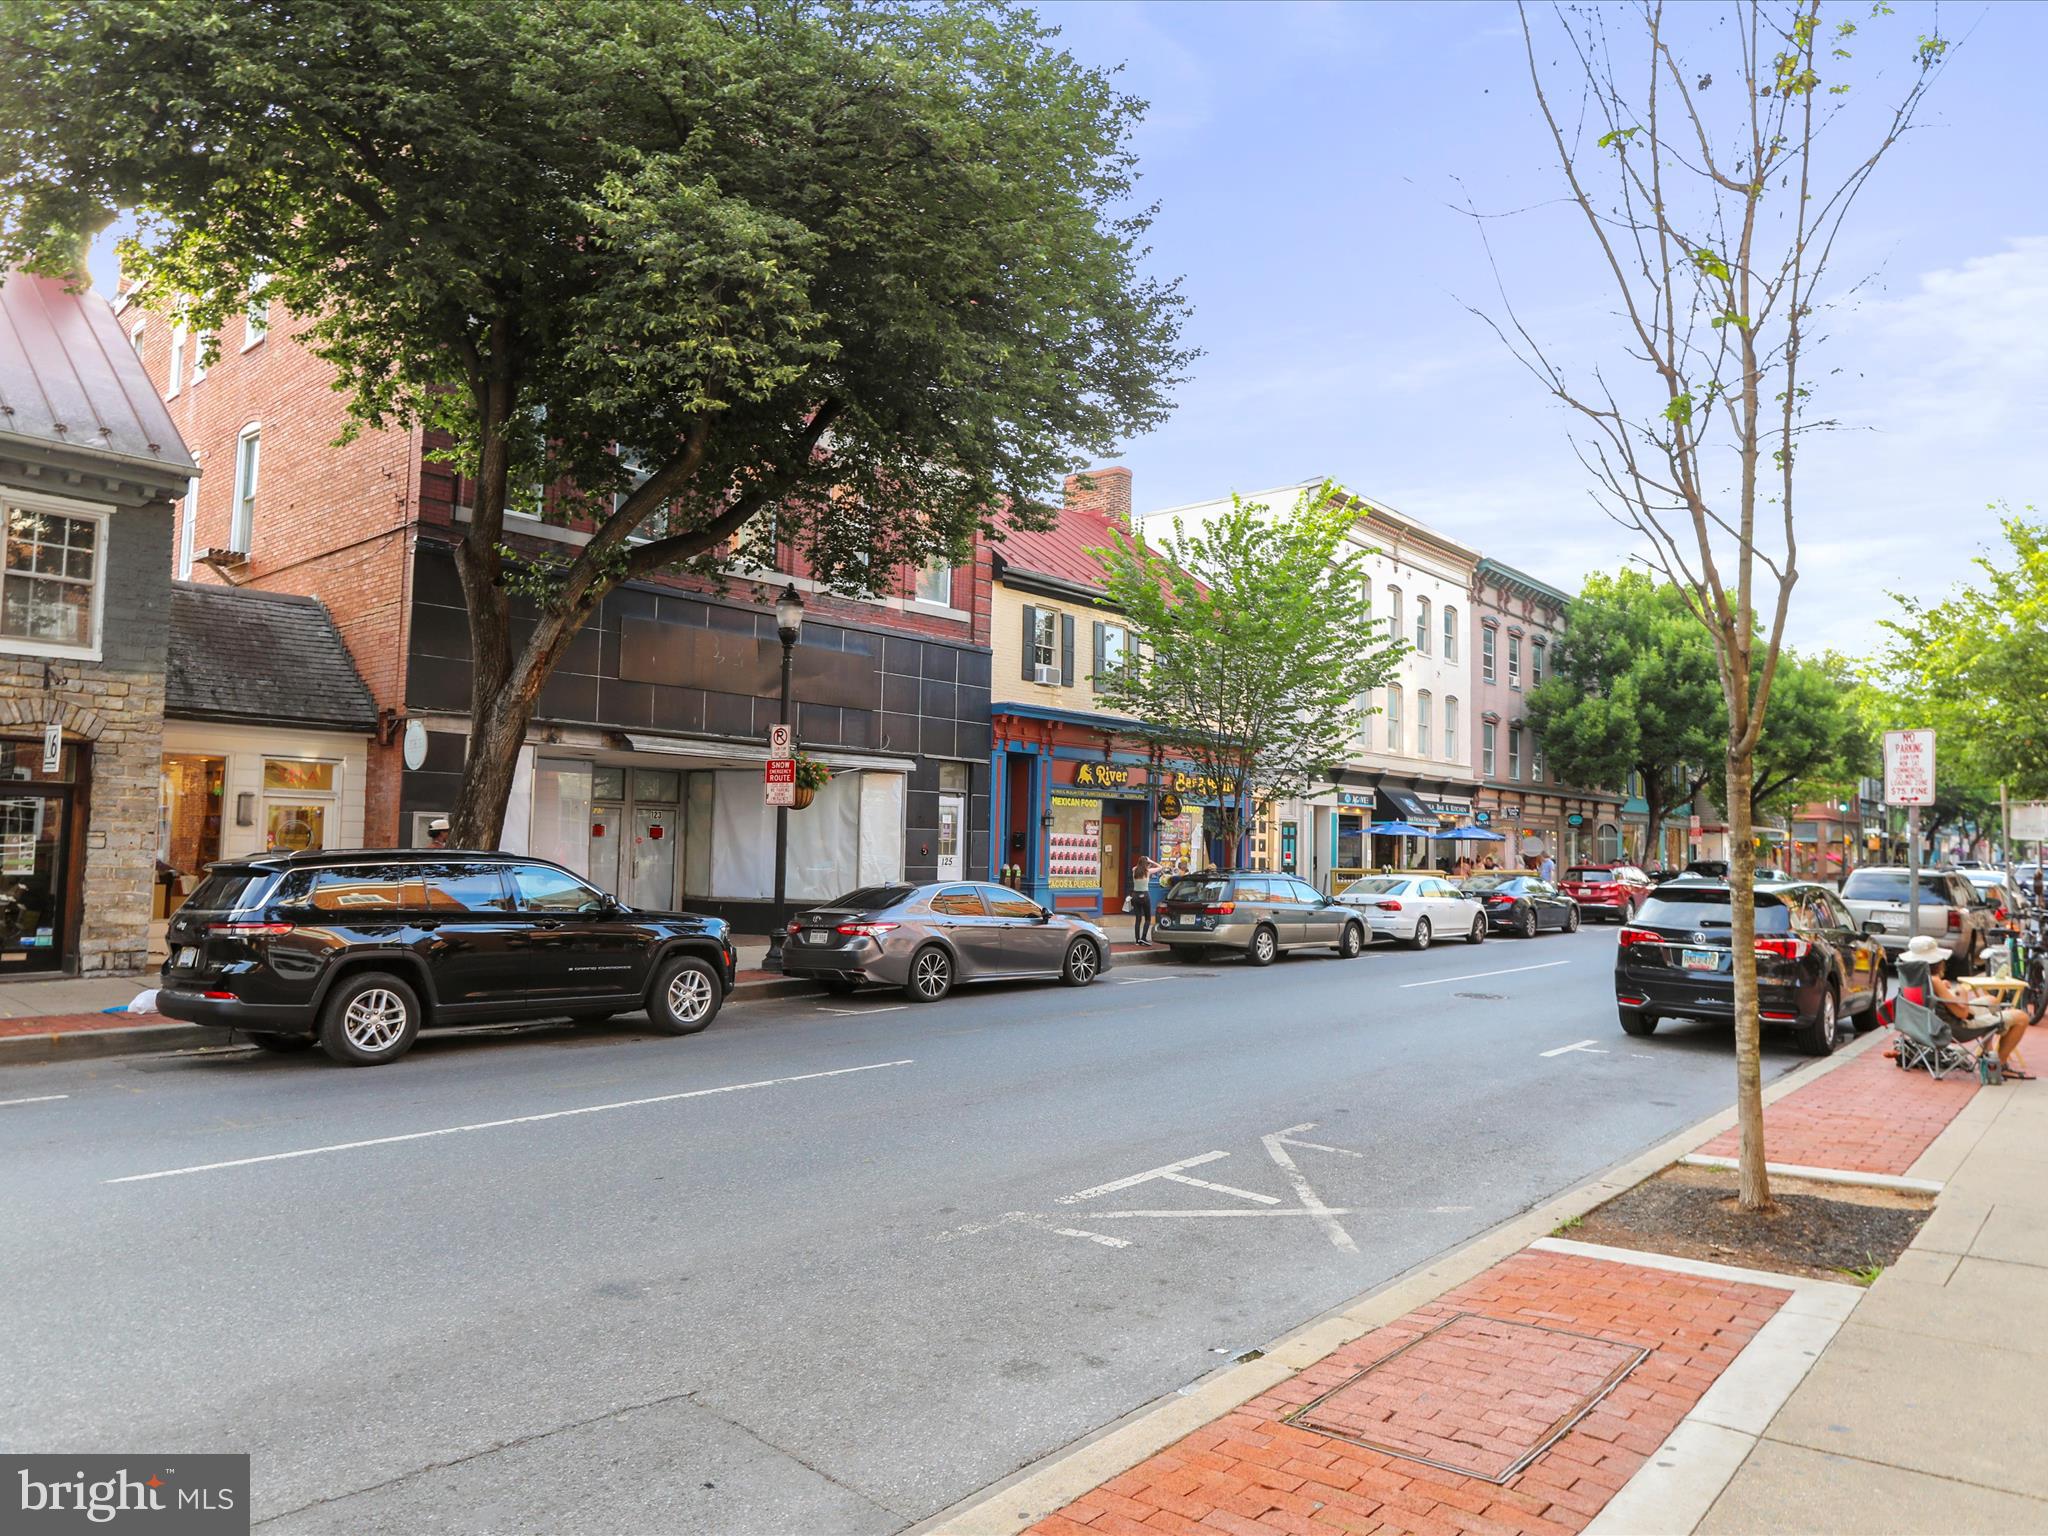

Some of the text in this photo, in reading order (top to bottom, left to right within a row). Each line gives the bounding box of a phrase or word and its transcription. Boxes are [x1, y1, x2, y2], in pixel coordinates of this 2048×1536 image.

[1903, 732, 1915, 742] NO
[1895, 743, 1924, 753] PARKING
[771, 761, 791, 769] SNOW
[769, 774, 791, 782] ROUTE
[1095, 765, 1128, 786] River
[1910, 787, 1929, 795] FINE
[1052, 796, 1098, 808] MEXICAN FOOD
[651, 811, 662, 819] 123
[941, 857, 953, 866] 125
